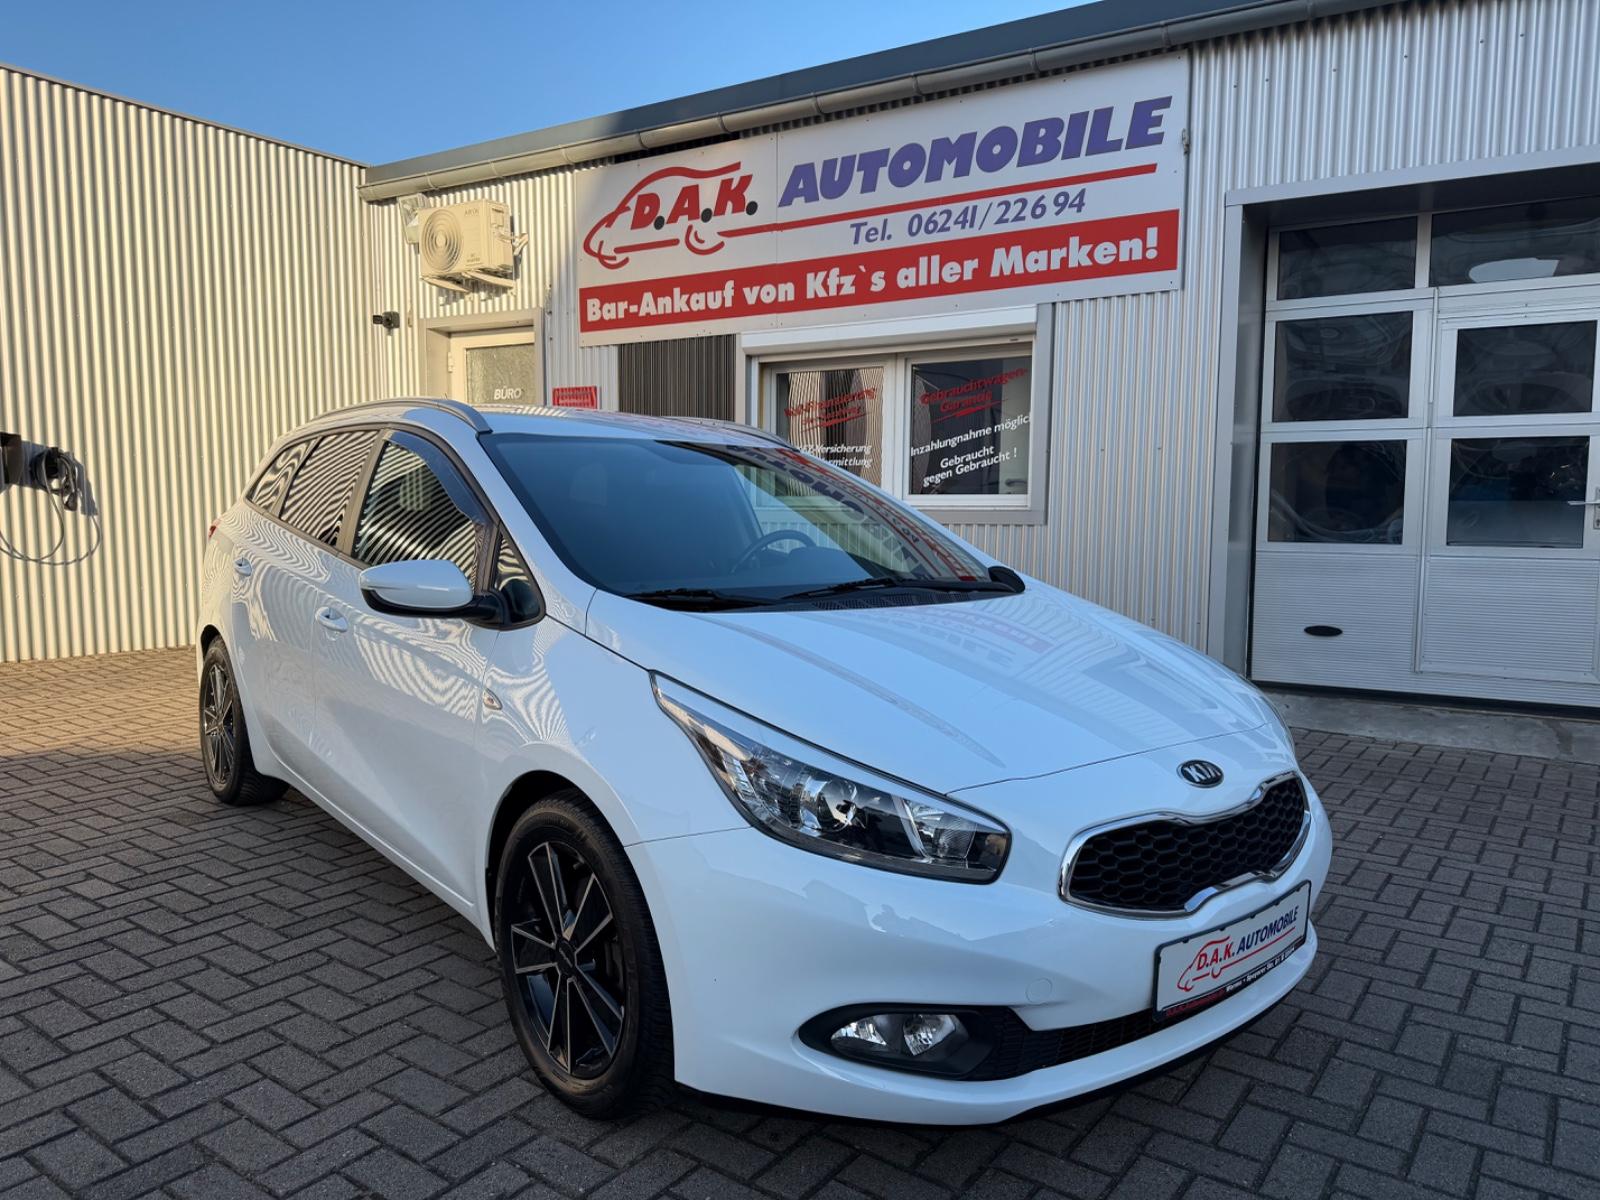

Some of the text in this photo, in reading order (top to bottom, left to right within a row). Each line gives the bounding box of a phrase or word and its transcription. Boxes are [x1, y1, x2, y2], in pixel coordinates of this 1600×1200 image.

[631, 95, 1173, 230] D.A.K. AUTOMOBILE
[850, 219, 892, 245] Tel.
[586, 280, 735, 322] Bar-Ankauf
[742, 281, 796, 306] von
[896, 254, 979, 289] aller
[990, 226, 1159, 278] Marken!
[493, 385, 522, 401] BÜRO
[993, 413, 1031, 433] möglic
[922, 469, 953, 488] gegen
[955, 450, 1011, 475] Gebraucht
[939, 445, 995, 469] Gebraucht
[1195, 940, 1235, 971] D.A.K.
[1236, 905, 1300, 956] AUTOMOBILE
